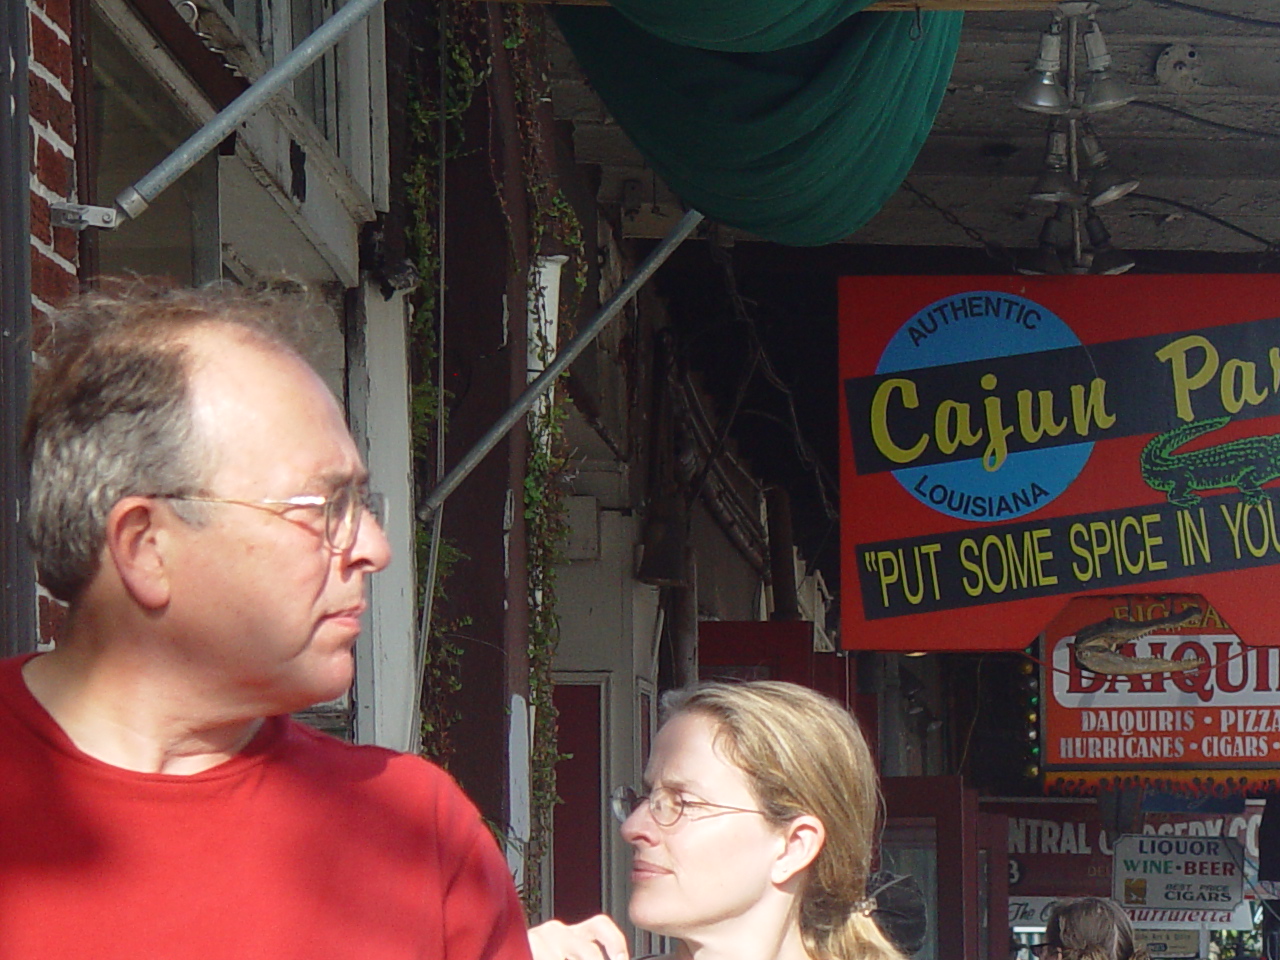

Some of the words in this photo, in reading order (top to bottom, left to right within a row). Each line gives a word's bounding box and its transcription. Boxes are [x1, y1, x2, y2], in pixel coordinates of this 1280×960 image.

[907, 297, 1042, 347] AUTHENTIC
[871, 373, 1116, 472] Cajun
[914, 474, 1050, 518] LOUISIANA
[865, 543, 942, 607] "PUT
[959, 528, 1058, 597] SOME
[1070, 513, 1168, 583] SPICE
[1178, 508, 1210, 567] IN
[1081, 709, 1195, 735] DAIQUIRIS
[1060, 736, 1184, 759] HURRICANES
[1201, 735, 1269, 758] CIGARS
[1008, 817, 1091, 855] NTRAL
[1139, 839, 1220, 856] LIQUOR
[1122, 859, 1174, 875] WINE
[1183, 860, 1236, 876] BEER
[1164, 890, 1233, 902] CIGARS
